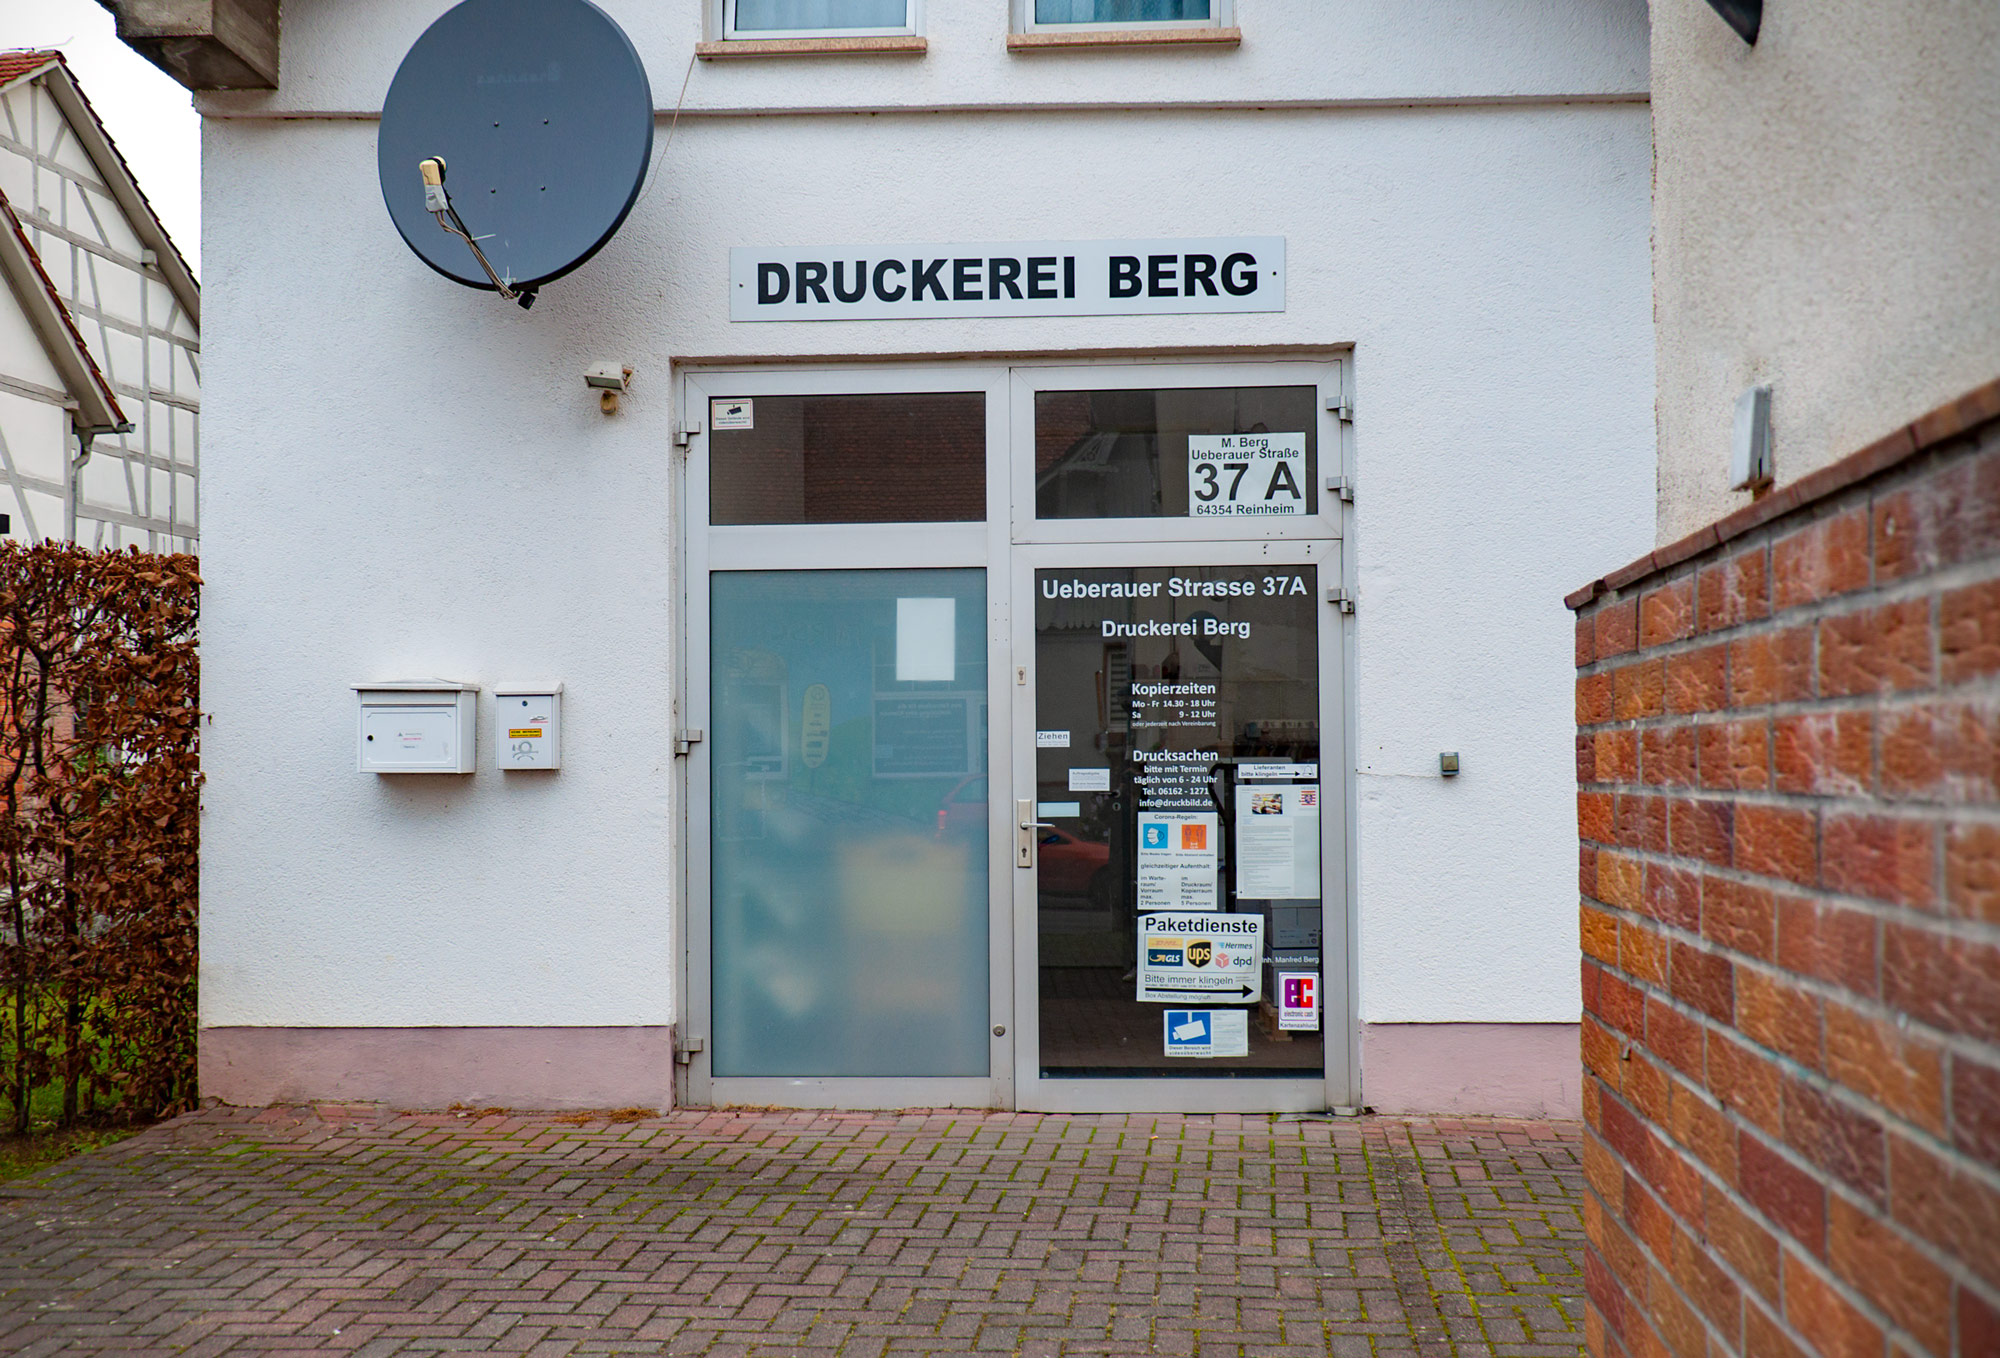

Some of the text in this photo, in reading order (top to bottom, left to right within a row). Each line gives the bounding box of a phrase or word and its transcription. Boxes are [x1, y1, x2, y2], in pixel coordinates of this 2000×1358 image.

[757, 252, 1259, 305] DRUCKEREI BERG
[1221, 437, 1269, 449] M. Berg
[1191, 447, 1299, 460] Ueberauer Straße
[1194, 461, 1302, 502] 37 A
[1196, 503, 1295, 515] 64354 Reinheim
[1042, 576, 1308, 599] Ueberauer Strasse 37A
[1102, 618, 1251, 639] Druckerei Berg
[1131, 682, 1216, 698] Kopierzeiten
[1132, 700, 1146, 708] Mo
[1151, 700, 1160, 708] Fr
[1163, 700, 1184, 708] 14.30
[1190, 699, 1200, 707] 18
[1201, 699, 1216, 707] Uhr
[1131, 711, 1142, 719] Sa
[1038, 732, 1068, 740] Ziehen
[1133, 749, 1219, 762] Drucksachen
[1144, 765, 1208, 773] bitte mit Termin
[1134, 776, 1160, 785] täglich
[1139, 799, 1213, 807] info@druckbild.de
[1145, 917, 1258, 933] Paketdienste
[1165, 954, 1180, 963] GLS
[1188, 948, 1211, 965] ups
[1233, 957, 1252, 967] dpd
[1275, 955, 1302, 963] Manfred
[1303, 954, 1319, 964] Berg
[1145, 974, 1165, 983] Bitte
[1168, 975, 1196, 983] immer
[1199, 975, 1233, 986] klingeln
